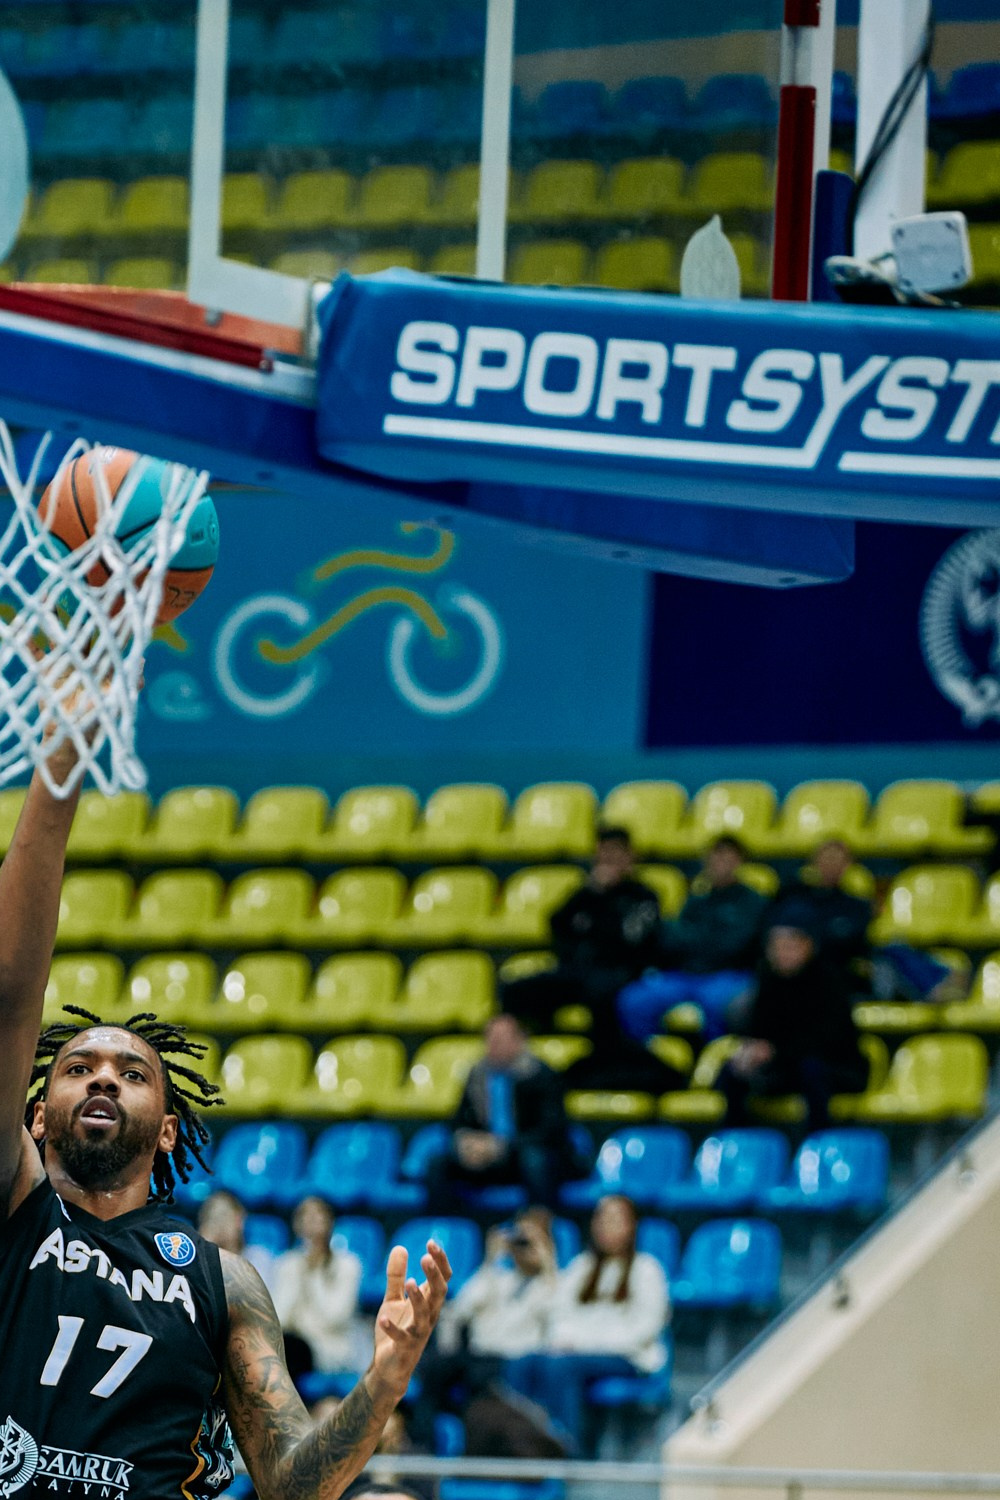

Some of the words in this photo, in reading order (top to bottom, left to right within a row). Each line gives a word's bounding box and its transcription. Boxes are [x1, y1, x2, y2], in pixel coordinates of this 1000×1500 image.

[390, 320, 1000, 450] SPORTSYST
[29, 1227, 196, 1324] ASTANA
[40, 1315, 153, 1398] 17
